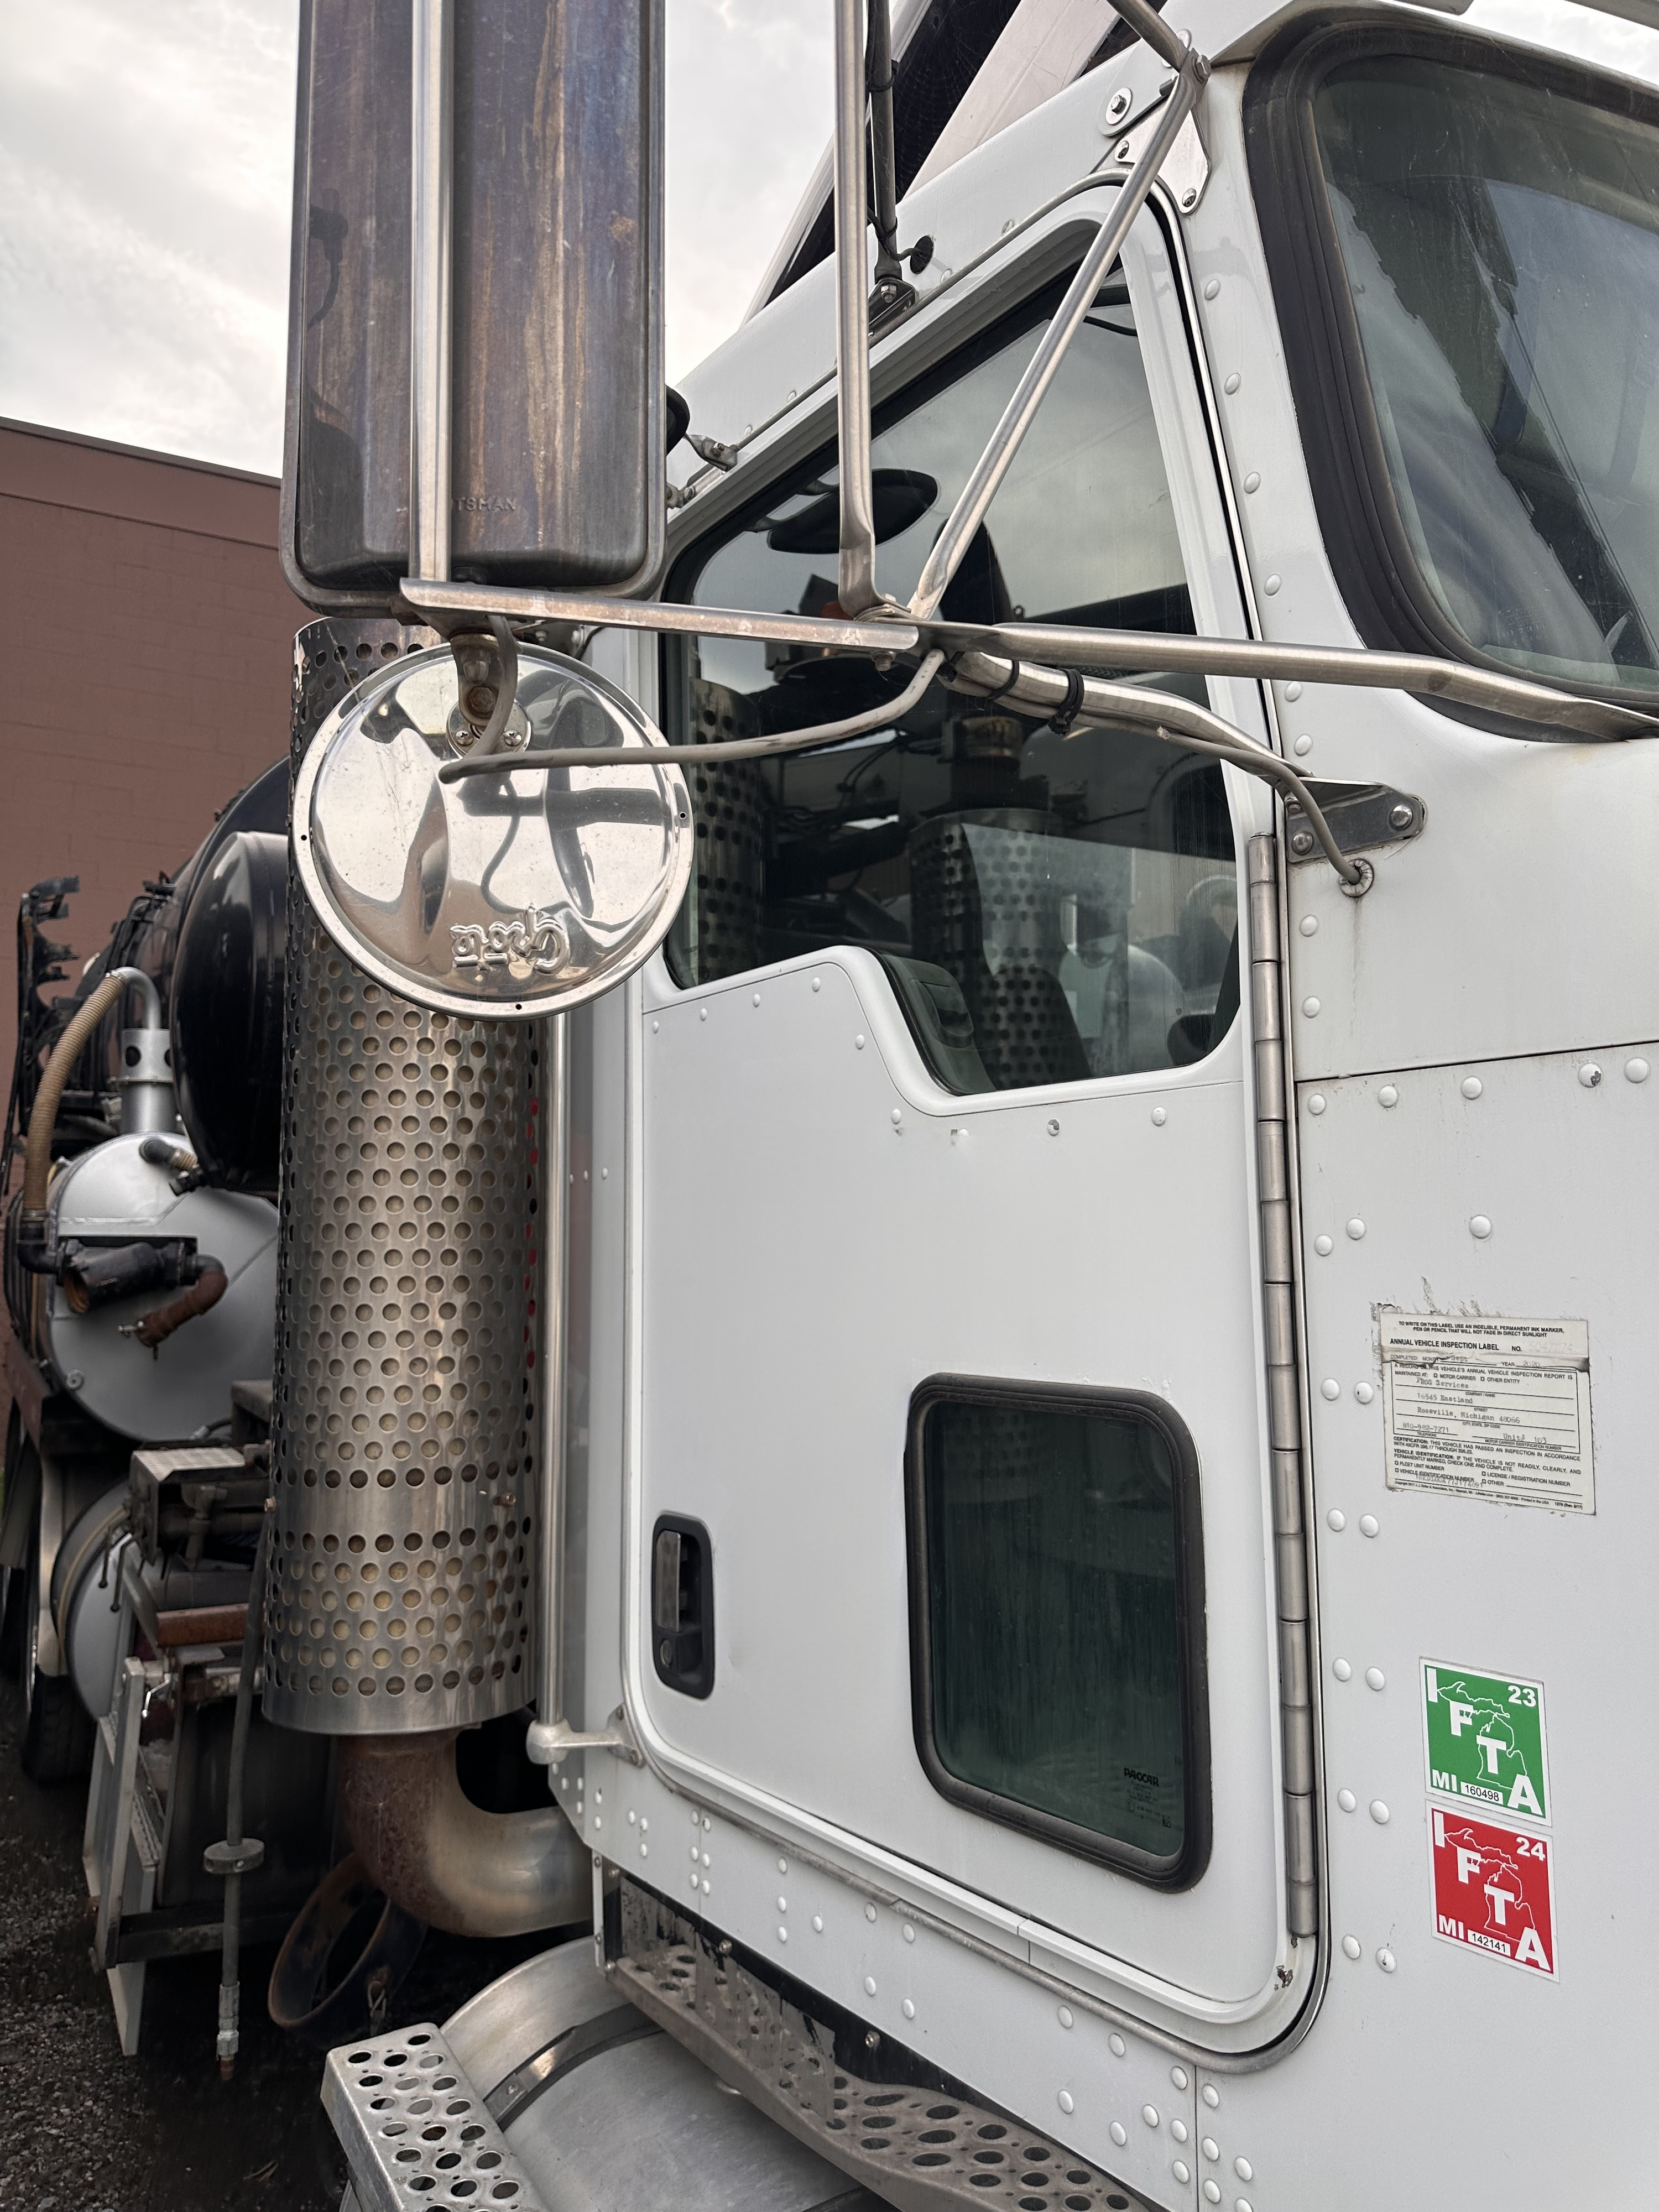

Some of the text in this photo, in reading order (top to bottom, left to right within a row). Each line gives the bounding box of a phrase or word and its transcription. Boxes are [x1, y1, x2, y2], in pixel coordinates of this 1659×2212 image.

[455, 497, 516, 511] TSMAN
[1441, 1341, 1477, 1349] INSPECTION
[1417, 1392, 1473, 1404] 16545 Eastland
[1417, 1407, 1457, 1418] Roseville,
[1461, 1411, 1494, 1421] Michigan
[1544, 1453, 1580, 1461] ACCORDANCE
[1511, 1475, 1547, 1484] REGISTRATION
[1507, 1686, 1536, 1707] 23
[1124, 1767, 1159, 1787] PACCAR
[1432, 1769, 1499, 1802] MI 160498
[1516, 1837, 1546, 1861] 24
[1438, 1914, 1507, 1954] MI 142141
